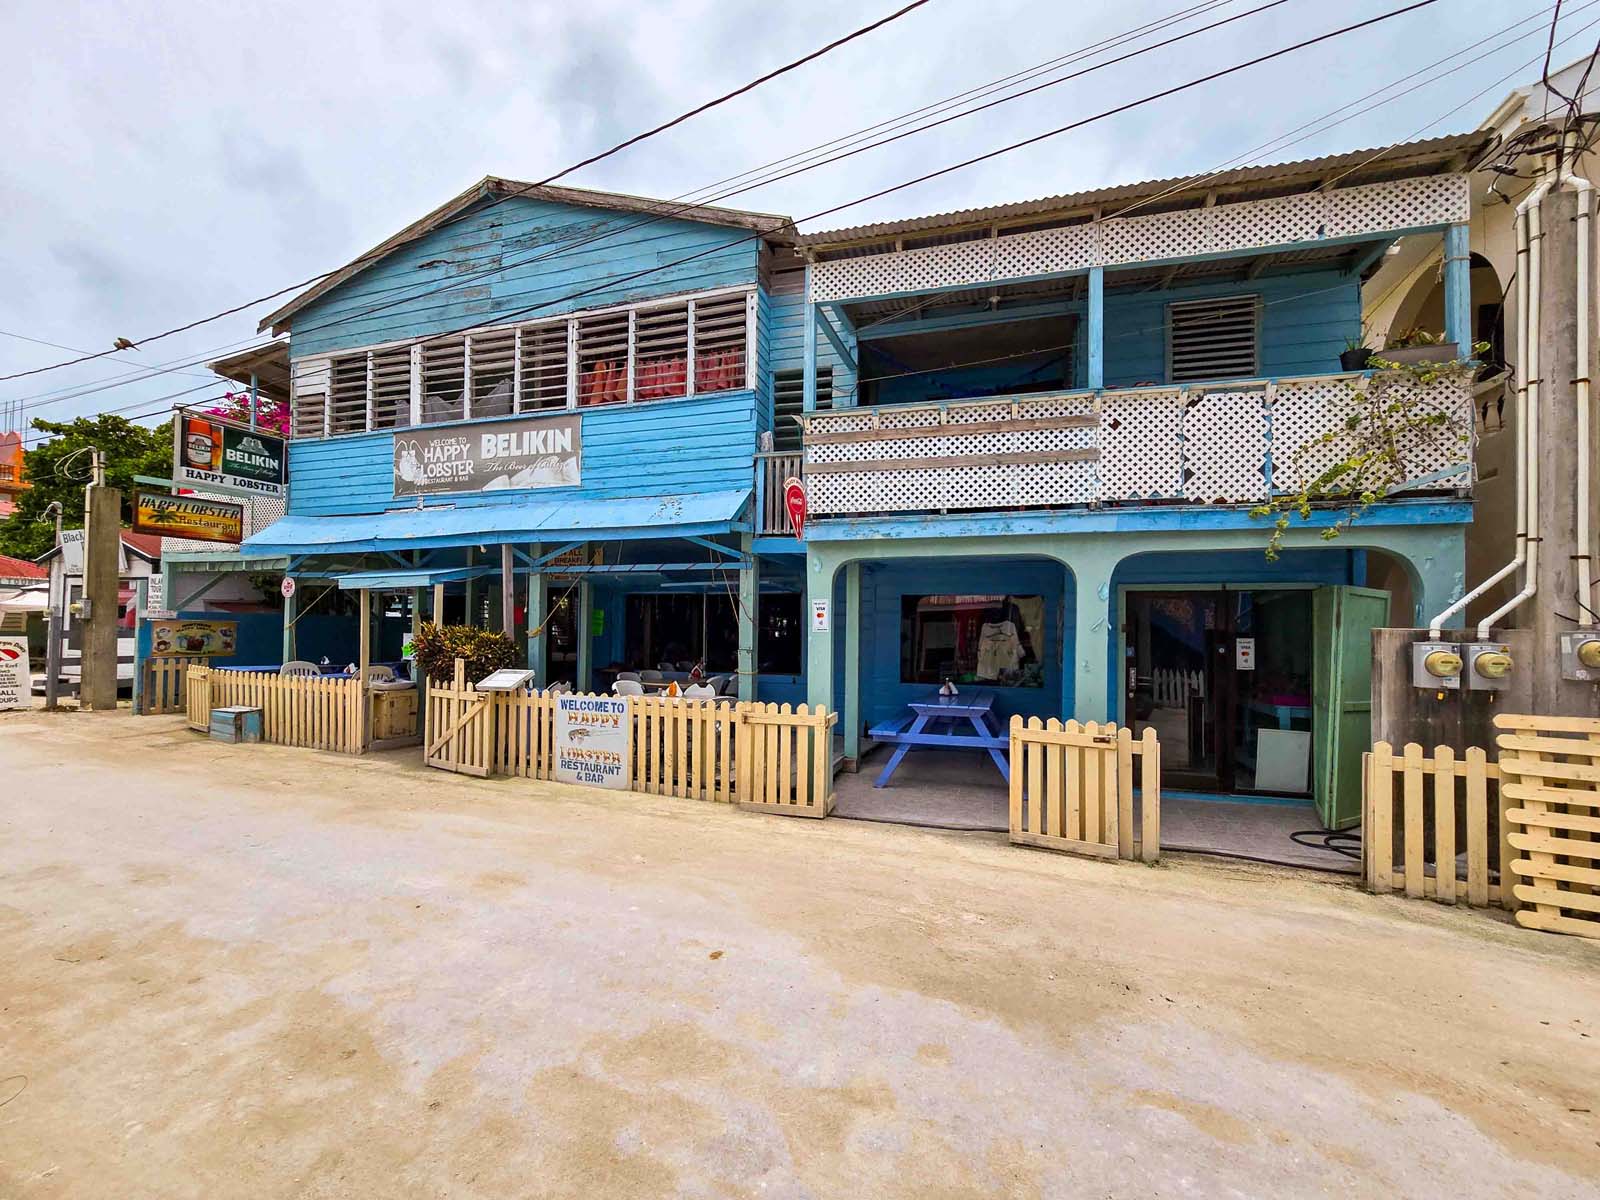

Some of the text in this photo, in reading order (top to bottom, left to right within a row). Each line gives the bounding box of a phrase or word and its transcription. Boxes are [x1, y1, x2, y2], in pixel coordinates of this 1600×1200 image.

[429, 438, 457, 447] WELCOME
[481, 427, 572, 459] BELIKIN
[226, 448, 279, 470] BELIKIN
[424, 444, 471, 463] HAPPY
[421, 460, 474, 477] LOBSTER
[483, 462, 502, 472] The
[504, 461, 527, 471] Beer
[186, 469, 279, 493] HAPPY LOBSTER
[140, 497, 239, 520] HAPPY LOBSTER
[179, 515, 238, 530] Restaurant
[560, 699, 625, 713] WELCOME TO
[568, 711, 620, 727] HAPPY
[560, 746, 621, 764] LOBSTER
[560, 760, 621, 775] RESTAURANT
[576, 772, 604, 783] & BAR
